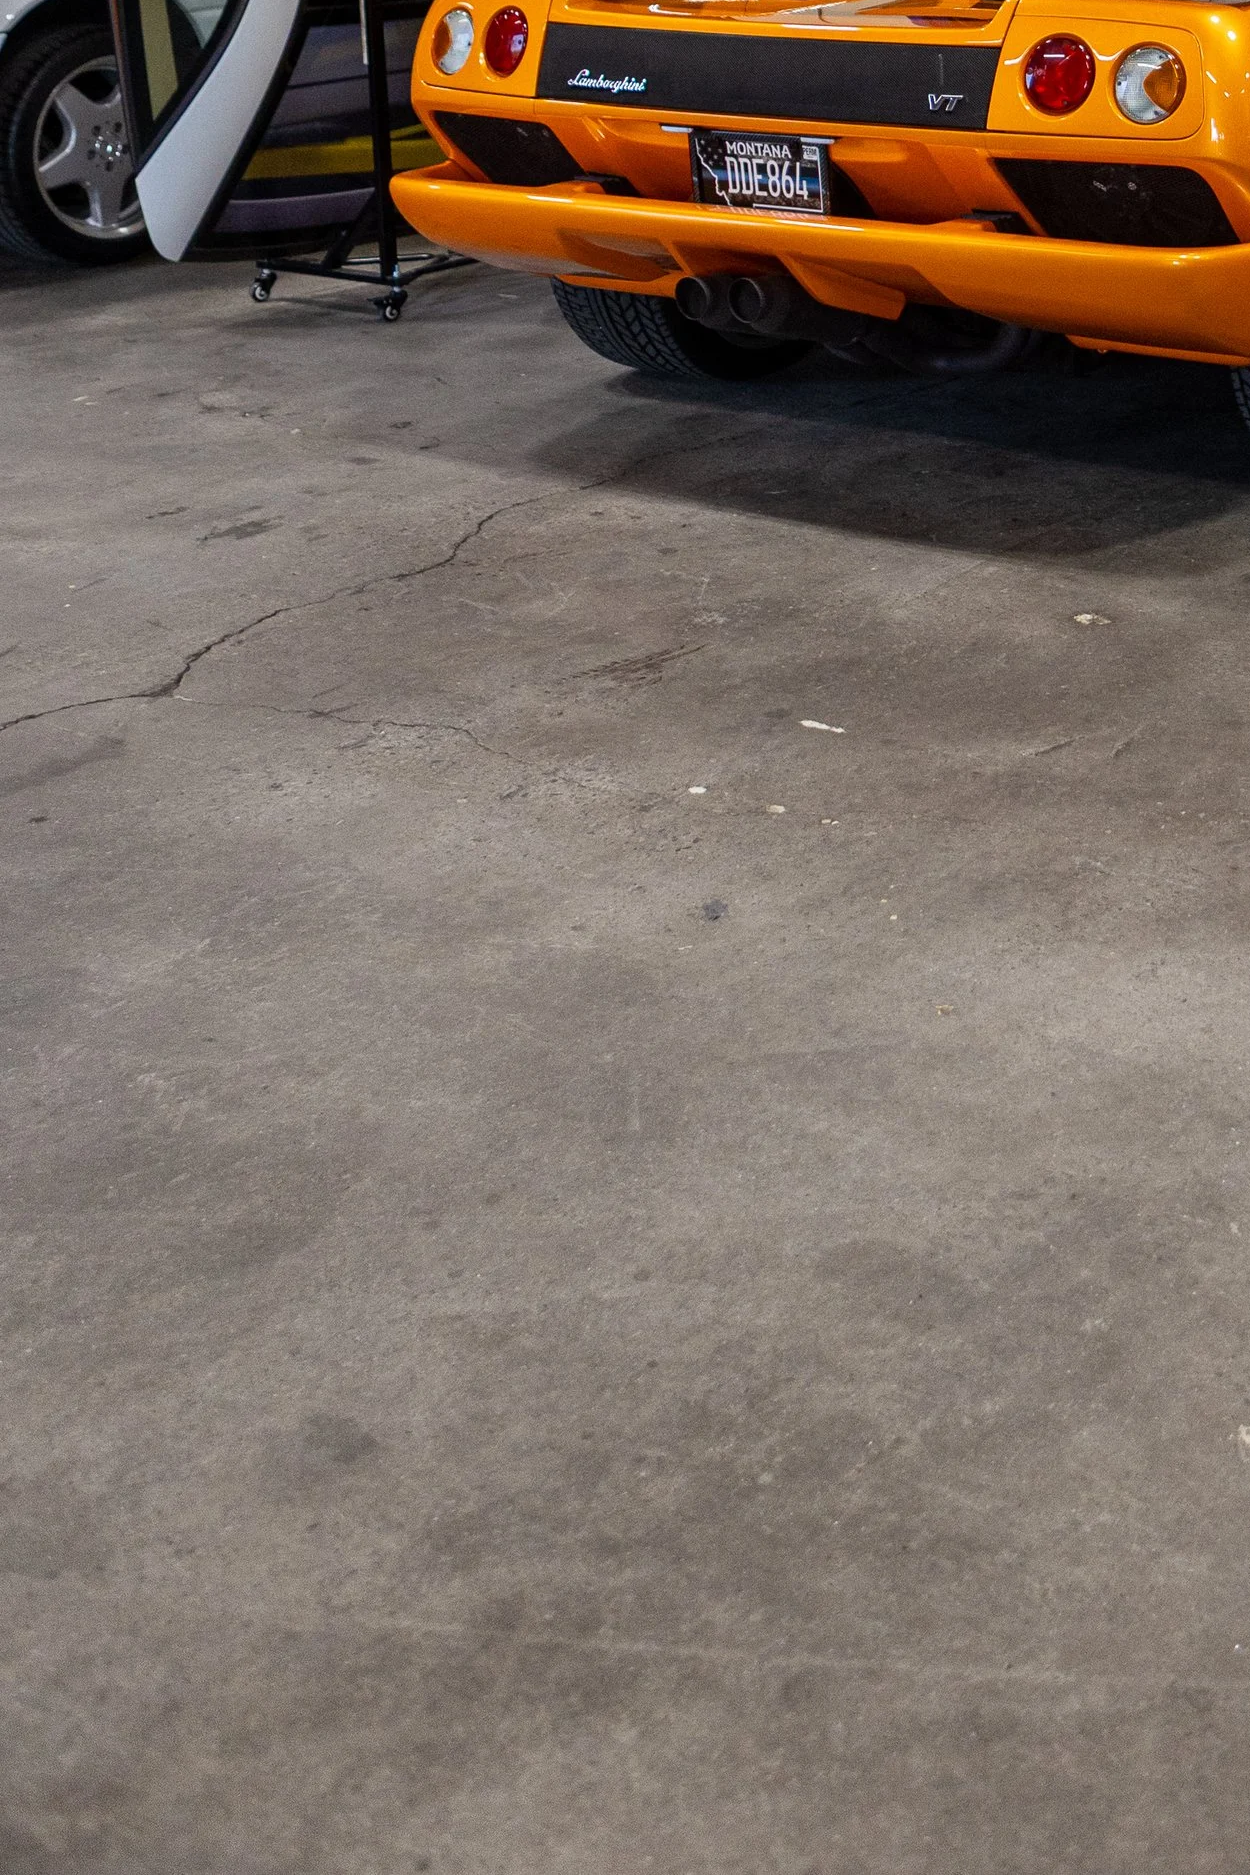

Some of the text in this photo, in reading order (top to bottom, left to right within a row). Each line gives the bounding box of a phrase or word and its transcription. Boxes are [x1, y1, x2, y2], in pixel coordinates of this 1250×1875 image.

[567, 68, 647, 94] Lamborghini
[928, 93, 964, 111] VT
[724, 140, 792, 159] MONTANA
[724, 156, 809, 201] DDE864
